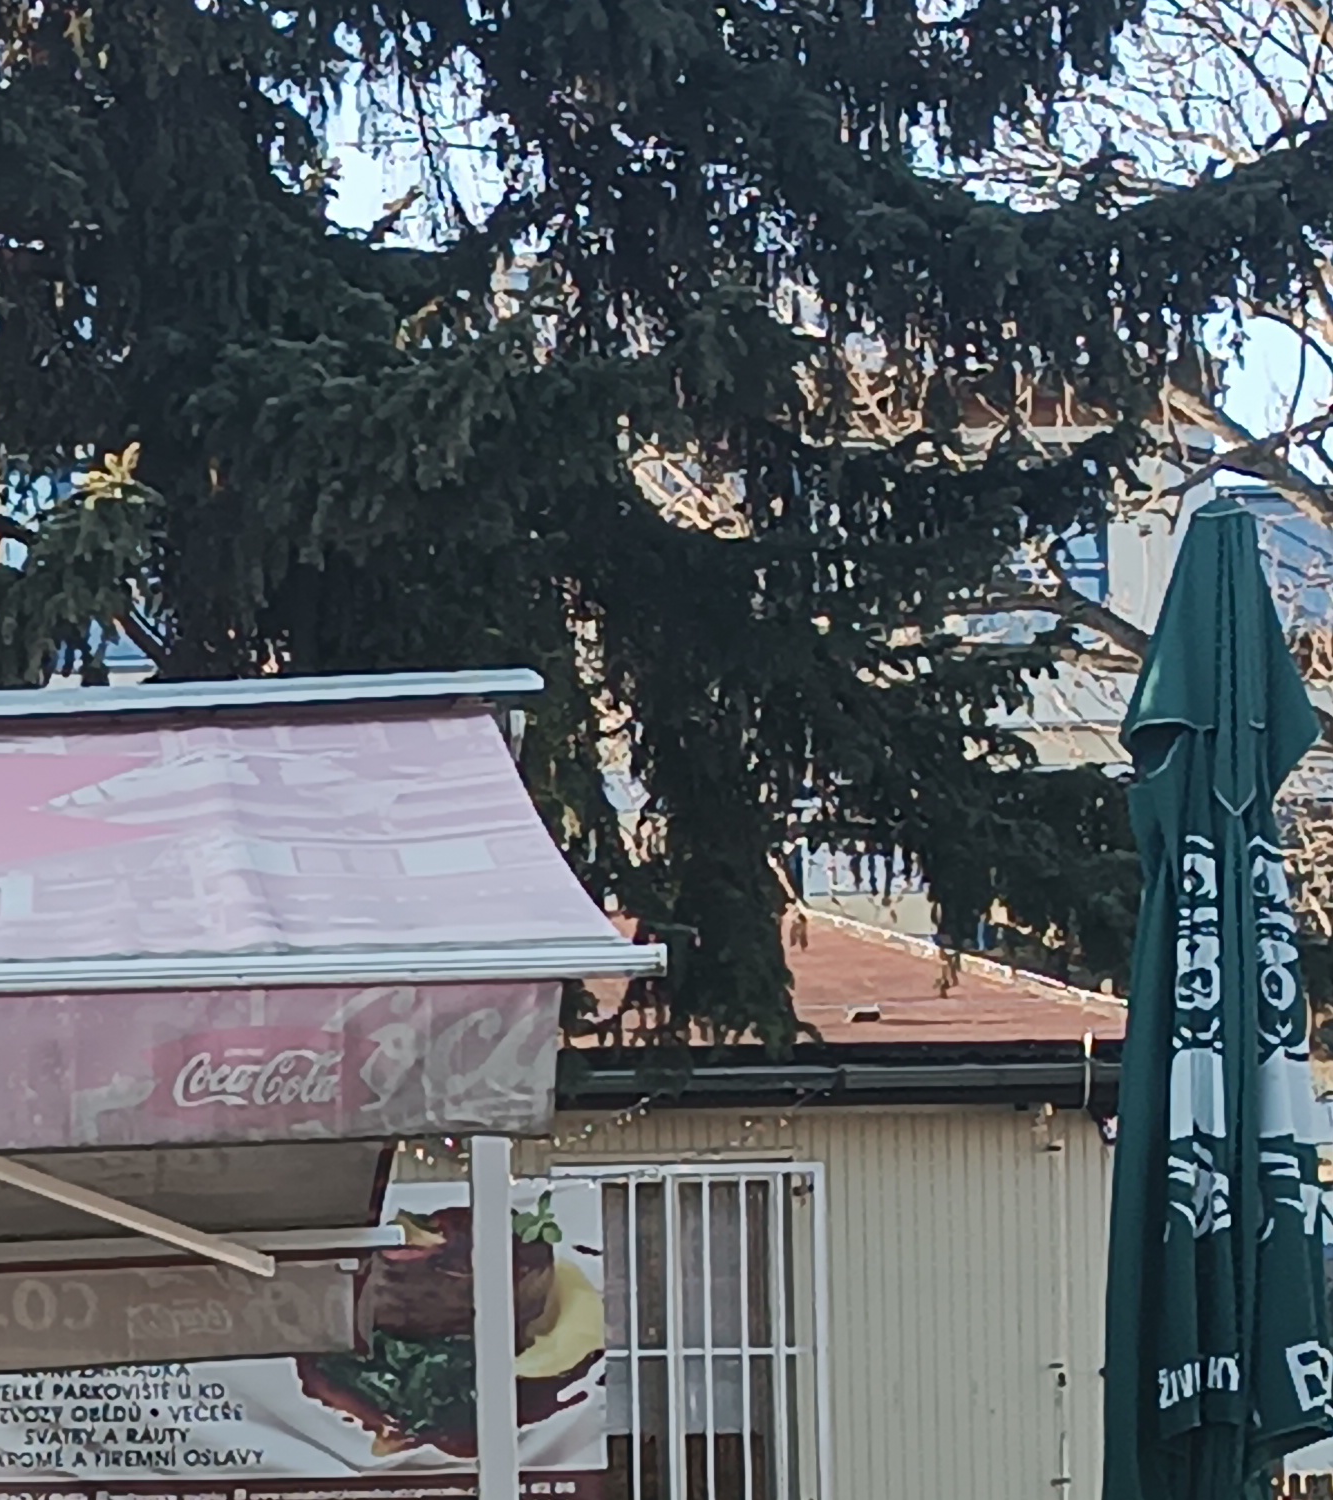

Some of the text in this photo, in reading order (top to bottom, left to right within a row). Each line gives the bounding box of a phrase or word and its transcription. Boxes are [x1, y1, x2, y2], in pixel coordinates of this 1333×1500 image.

[198, 1382, 226, 1400] KD
[103, 1427, 119, 1444] A
[71, 1450, 85, 1468] A
